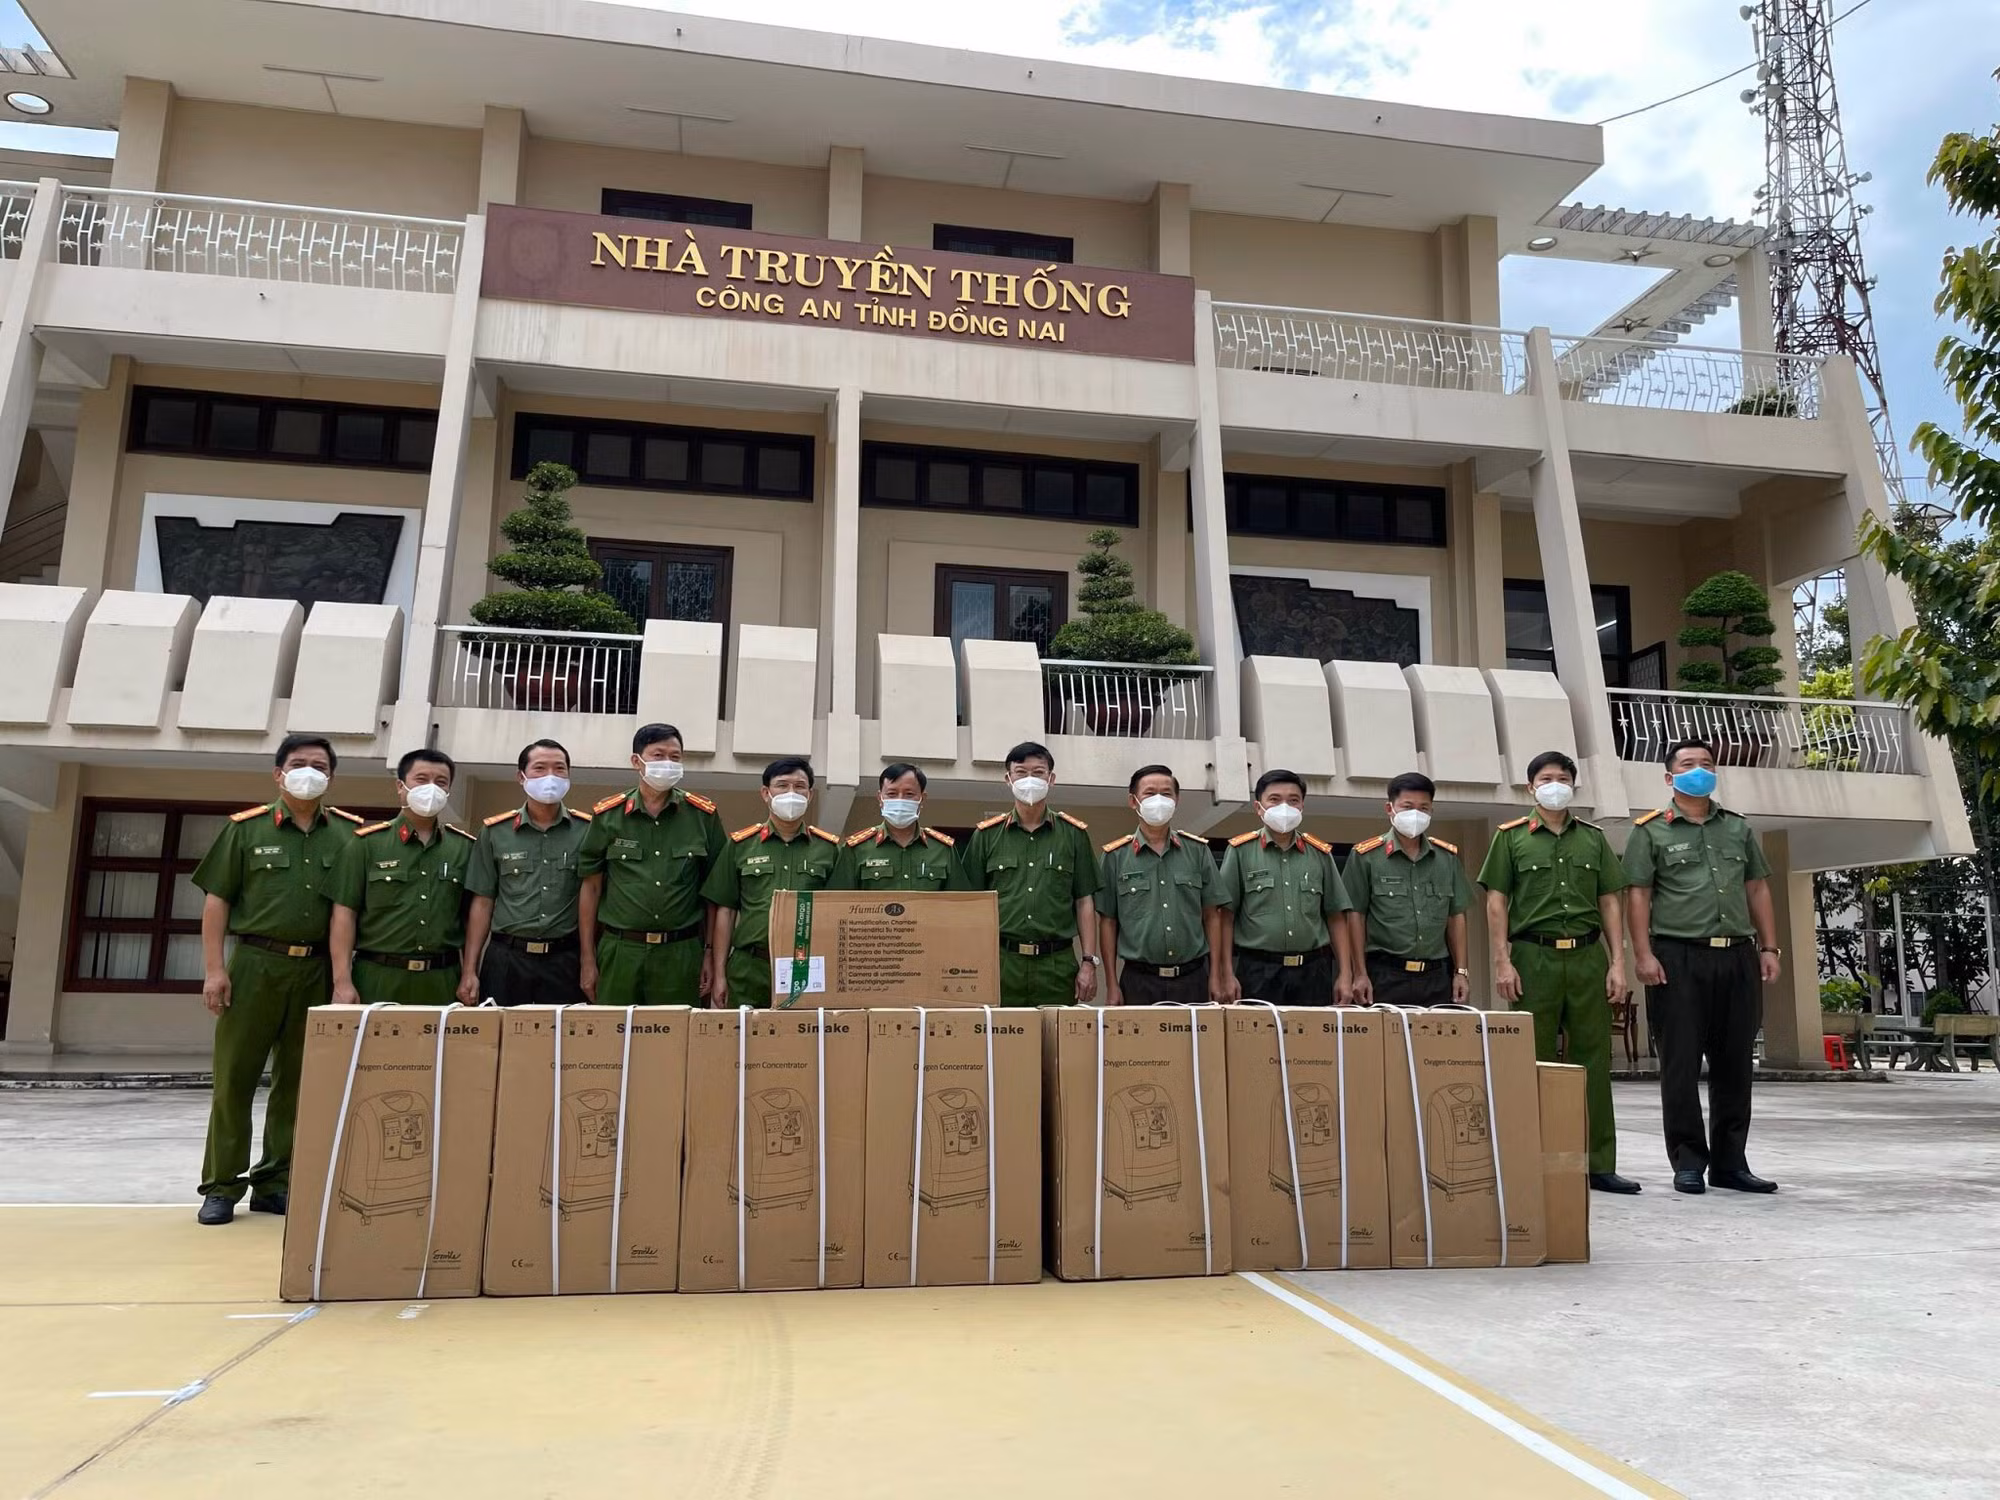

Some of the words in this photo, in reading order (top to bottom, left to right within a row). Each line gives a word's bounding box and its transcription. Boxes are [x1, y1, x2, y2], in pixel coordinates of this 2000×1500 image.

[591, 229, 709, 276] NHÀ
[720, 245, 937, 299] TRUYỀN
[950, 264, 1132, 318] THỐNG
[696, 284, 784, 315] CÔNG
[799, 298, 842, 321] AN
[854, 297, 917, 329] TỈNH
[928, 306, 1008, 337] ĐỒNG
[1018, 319, 1065, 342] NAI
[616, 1023, 671, 1034] Smake
[1475, 1024, 1520, 1035] Smake
[383, 1063, 433, 1071] Concentrator
[550, 1062, 577, 1071] Oygen
[578, 1062, 623, 1070] Concentrato
[734, 1062, 761, 1070] Oygen
[761, 1061, 808, 1069] Concentrator
[913, 1063, 939, 1072] Oygen
[939, 1063, 984, 1071] Concentrator
[1128, 1059, 1171, 1067] Concentrator
